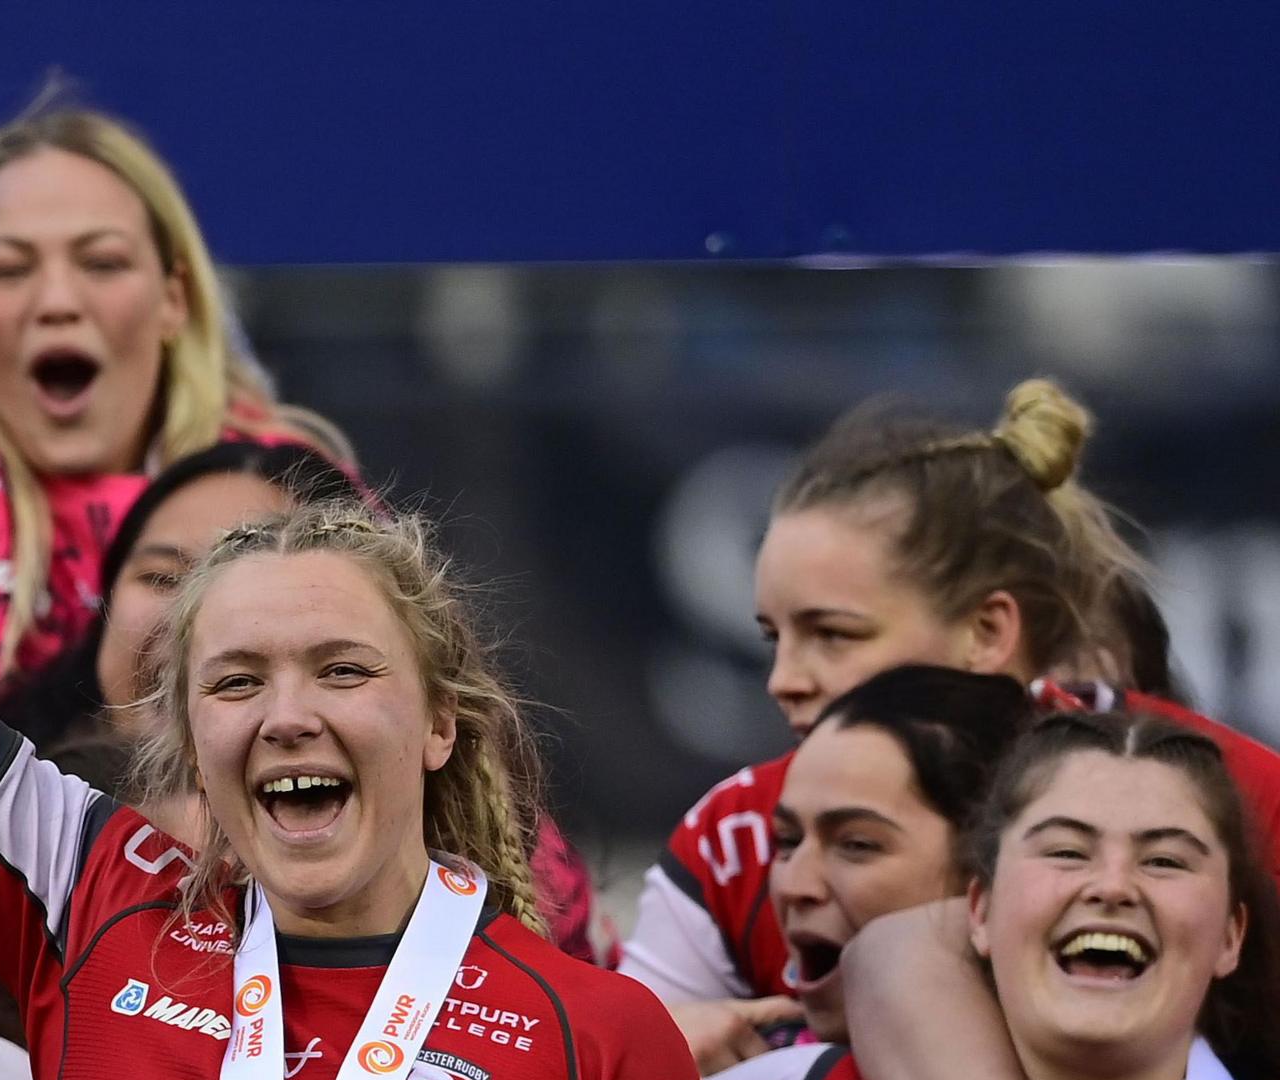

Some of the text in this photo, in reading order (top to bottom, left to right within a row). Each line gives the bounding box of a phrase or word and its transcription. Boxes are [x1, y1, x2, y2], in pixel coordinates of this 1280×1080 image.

[384, 994, 416, 1038] PWR
[445, 998, 540, 1032] TPURY
[246, 1017, 263, 1059] PWR
[417, 1050, 455, 1069] CESTER
